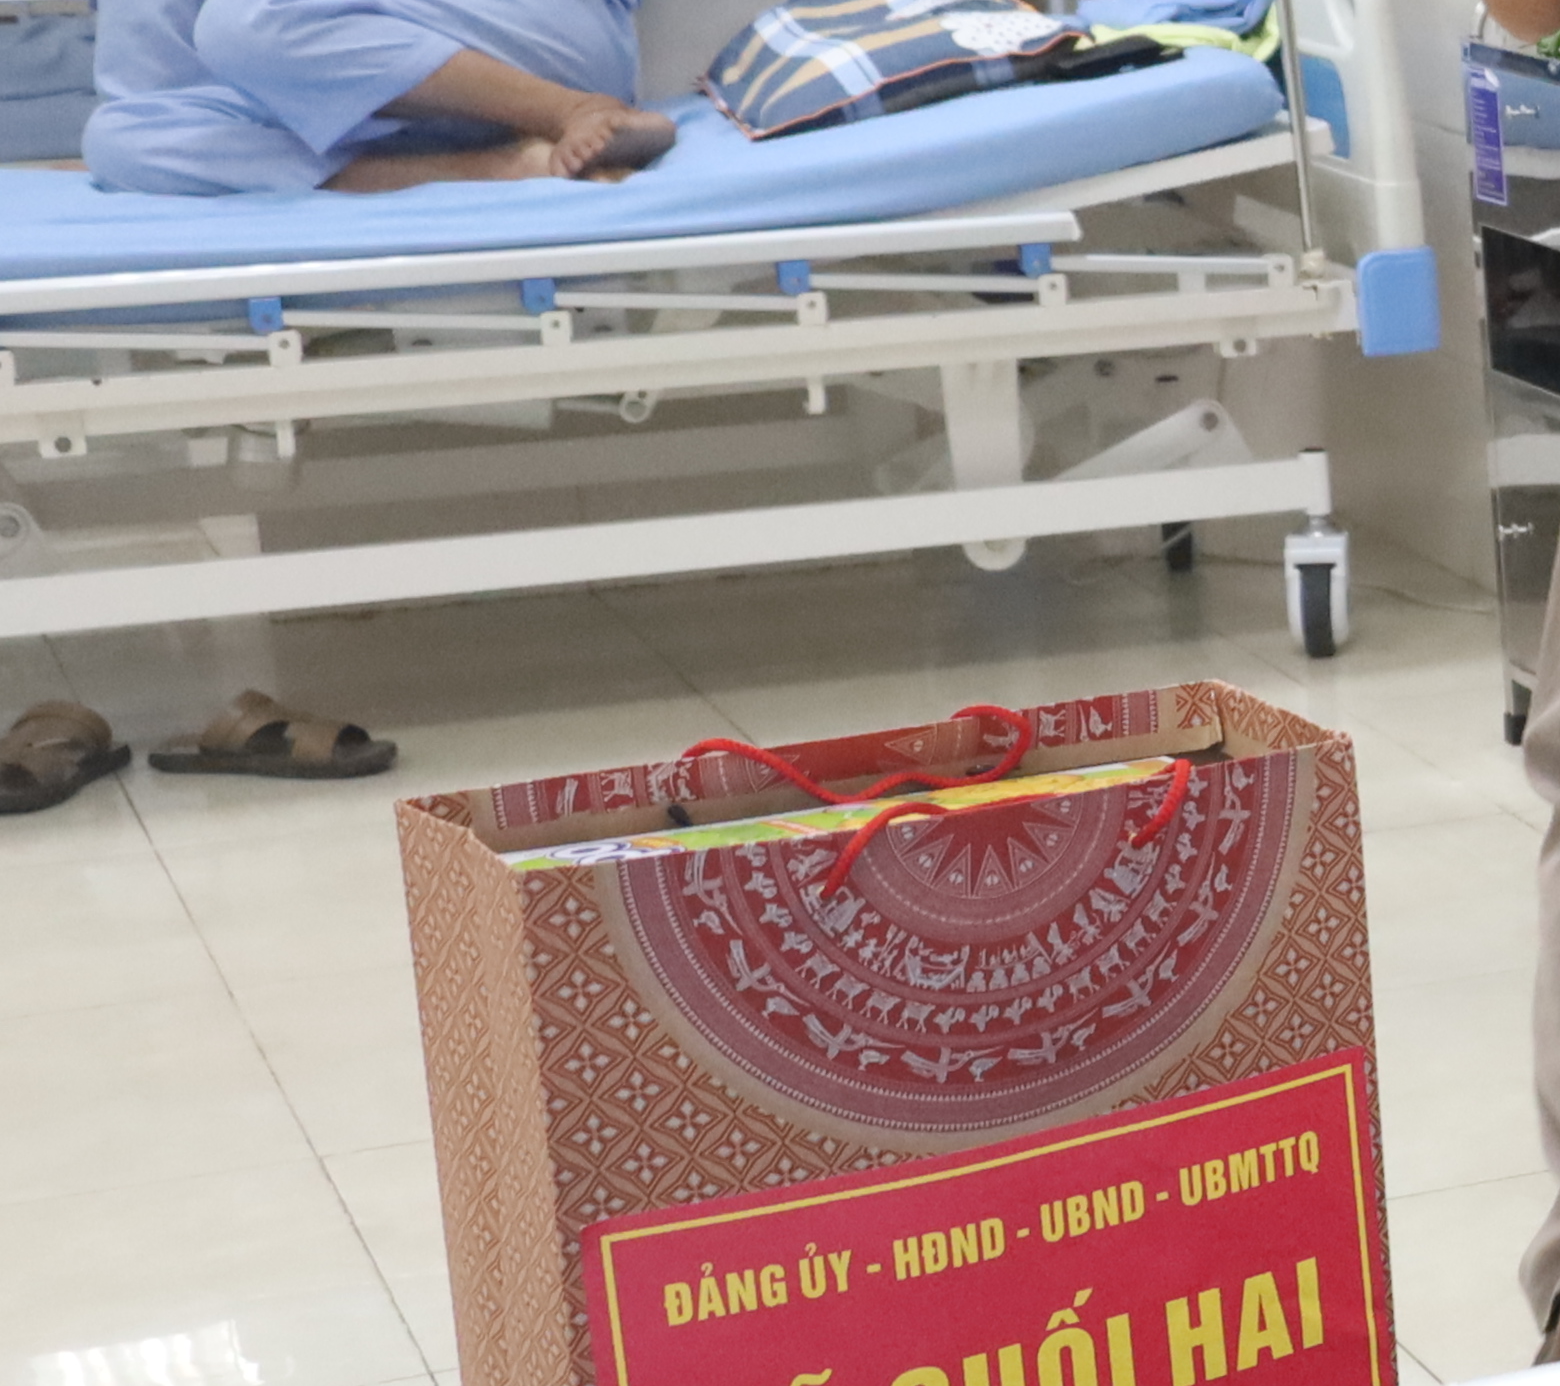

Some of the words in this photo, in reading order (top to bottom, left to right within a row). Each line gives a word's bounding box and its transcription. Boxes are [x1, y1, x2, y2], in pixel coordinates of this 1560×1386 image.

[664, 1262, 788, 1327] ĐẢNG
[799, 1242, 852, 1299] ỦY
[893, 1217, 1006, 1281] HĐND
[1040, 1180, 1146, 1243] UBND
[1179, 1130, 1321, 1207] UBMTTQ
